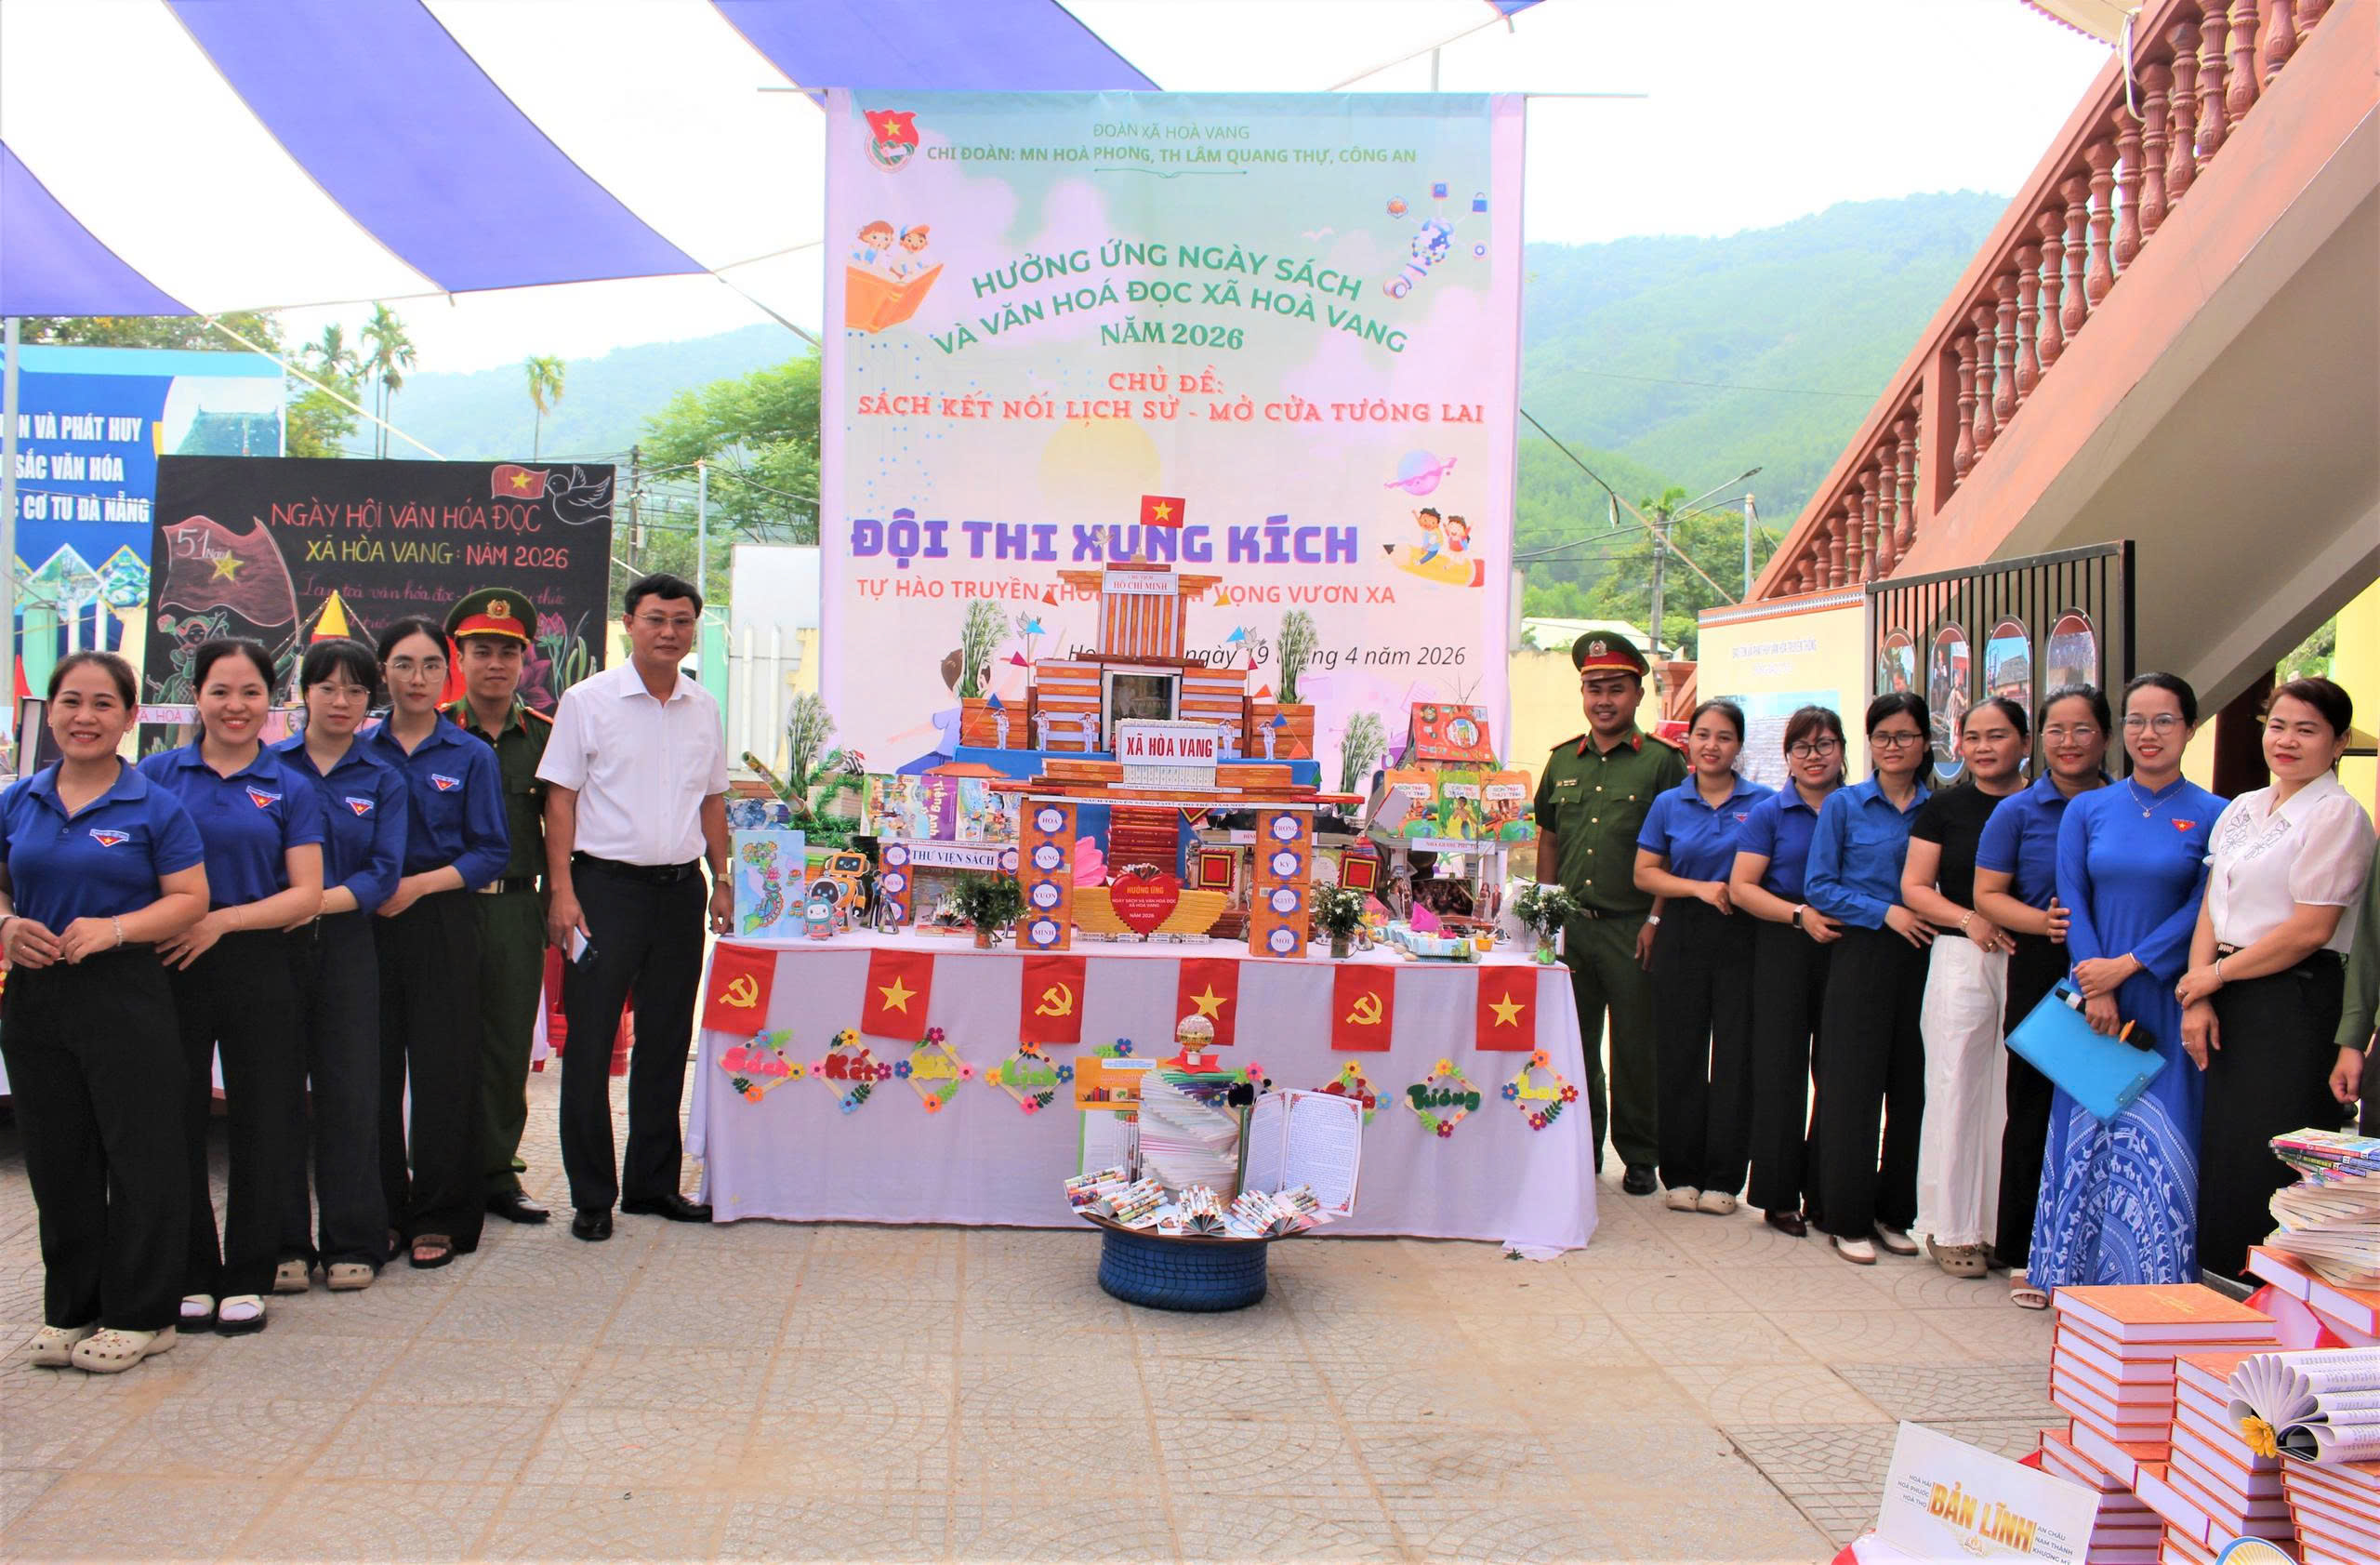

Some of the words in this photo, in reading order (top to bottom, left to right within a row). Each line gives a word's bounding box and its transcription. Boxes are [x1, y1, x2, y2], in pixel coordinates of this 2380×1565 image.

[1093, 122, 1138, 138] ĐOÀN
[1142, 123, 1160, 139] XÃ
[1166, 123, 1200, 139] HOÀ
[1205, 126, 1250, 139] VANG
[927, 147, 957, 161] CHI
[960, 144, 1015, 162] ĐOÀN:
[1021, 148, 1048, 162] MN
[1054, 144, 1089, 162] HOÀ
[1093, 146, 1154, 164] PHONG,
[1159, 149, 1181, 163] TH
[1186, 146, 1221, 163] LÂM
[1226, 149, 1289, 166] QUANG
[1294, 148, 1333, 166] THỰ,
[1339, 145, 1387, 163] CÔNG
[1392, 149, 1416, 163] AN
[972, 249, 1091, 298] HƯỞNG
[1100, 238, 1168, 268] ỨNG
[1178, 244, 1268, 275] NGÀY
[1275, 259, 1362, 301] SÁCH
[933, 322, 979, 354] VÀ
[979, 301, 1044, 336] VĂN
[1051, 278, 1119, 316] HOÁ
[1126, 280, 1192, 308] ĐỌC
[1201, 279, 1241, 307] XÃ
[1250, 287, 1316, 322] HOÀ
[1327, 304, 1408, 352] VANG
[1100, 315, 1166, 346] NĂM
[1171, 323, 1244, 350] 2026
[1108, 365, 1169, 392] CHỦ
[1179, 364, 1224, 394] ĐỀ:
[857, 392, 932, 417] SÁCH
[942, 391, 994, 418] KẾT
[1002, 391, 1055, 419] NỐI
[1065, 400, 1132, 428] LỊCH
[1143, 393, 1181, 419] SỬ
[1209, 393, 1254, 421] MỞ
[1264, 394, 1324, 423] CỬA
[1330, 397, 1431, 423] TƯƠNG
[1441, 403, 1485, 424] LAI
[34, 411, 58, 440] VÀ
[61, 412, 105, 441] PHÁT
[108, 416, 143, 443] HUY
[15, 447, 47, 480] SẮC
[51, 452, 86, 481] VĂN
[89, 453, 125, 482] HÓA
[23, 493, 47, 521] CƠ
[51, 496, 73, 521] TU
[76, 493, 101, 522] ĐÀ
[105, 490, 151, 524] NẴNG
[271, 497, 339, 527] NGÀY
[346, 498, 382, 532] HỘI
[390, 499, 436, 529] VĂN
[443, 496, 487, 530] HÓA
[492, 504, 541, 537] ĐỌC
[176, 527, 210, 558] 51
[305, 535, 336, 562] XÃ
[341, 535, 385, 563] HÒA
[466, 541, 508, 566] NĂM
[514, 545, 569, 569] 2026
[851, 507, 948, 569] ĐỘI
[961, 520, 1058, 561] THI
[1072, 524, 1212, 564] XUNG
[1227, 514, 1357, 564] KÍCH
[857, 577, 888, 602] TỰ
[895, 575, 945, 598] HÀO
[950, 576, 1039, 601] TRUYỀN
[1214, 585, 1281, 606] VỌNG
[1288, 584, 1358, 603] VƯƠN
[1366, 586, 1395, 603] XA
[1185, 644, 1237, 670] ngày
[1345, 645, 1358, 666] 4
[1364, 645, 1410, 666] năm
[1417, 645, 1466, 666] 2026
[1127, 733, 1144, 756] XÃ
[1148, 733, 1174, 756] HÒA
[1179, 738, 1213, 758] VANG
[929, 814, 941, 836] Anh
[912, 849, 935, 860] THƯ
[938, 851, 963, 865] VIỆN
[1930, 1479, 1978, 1531] BẢN
[1978, 1500, 2036, 1554] LĨNH
[2037, 1525, 2047, 1534] AN
[2035, 1535, 2051, 1547] NAM
